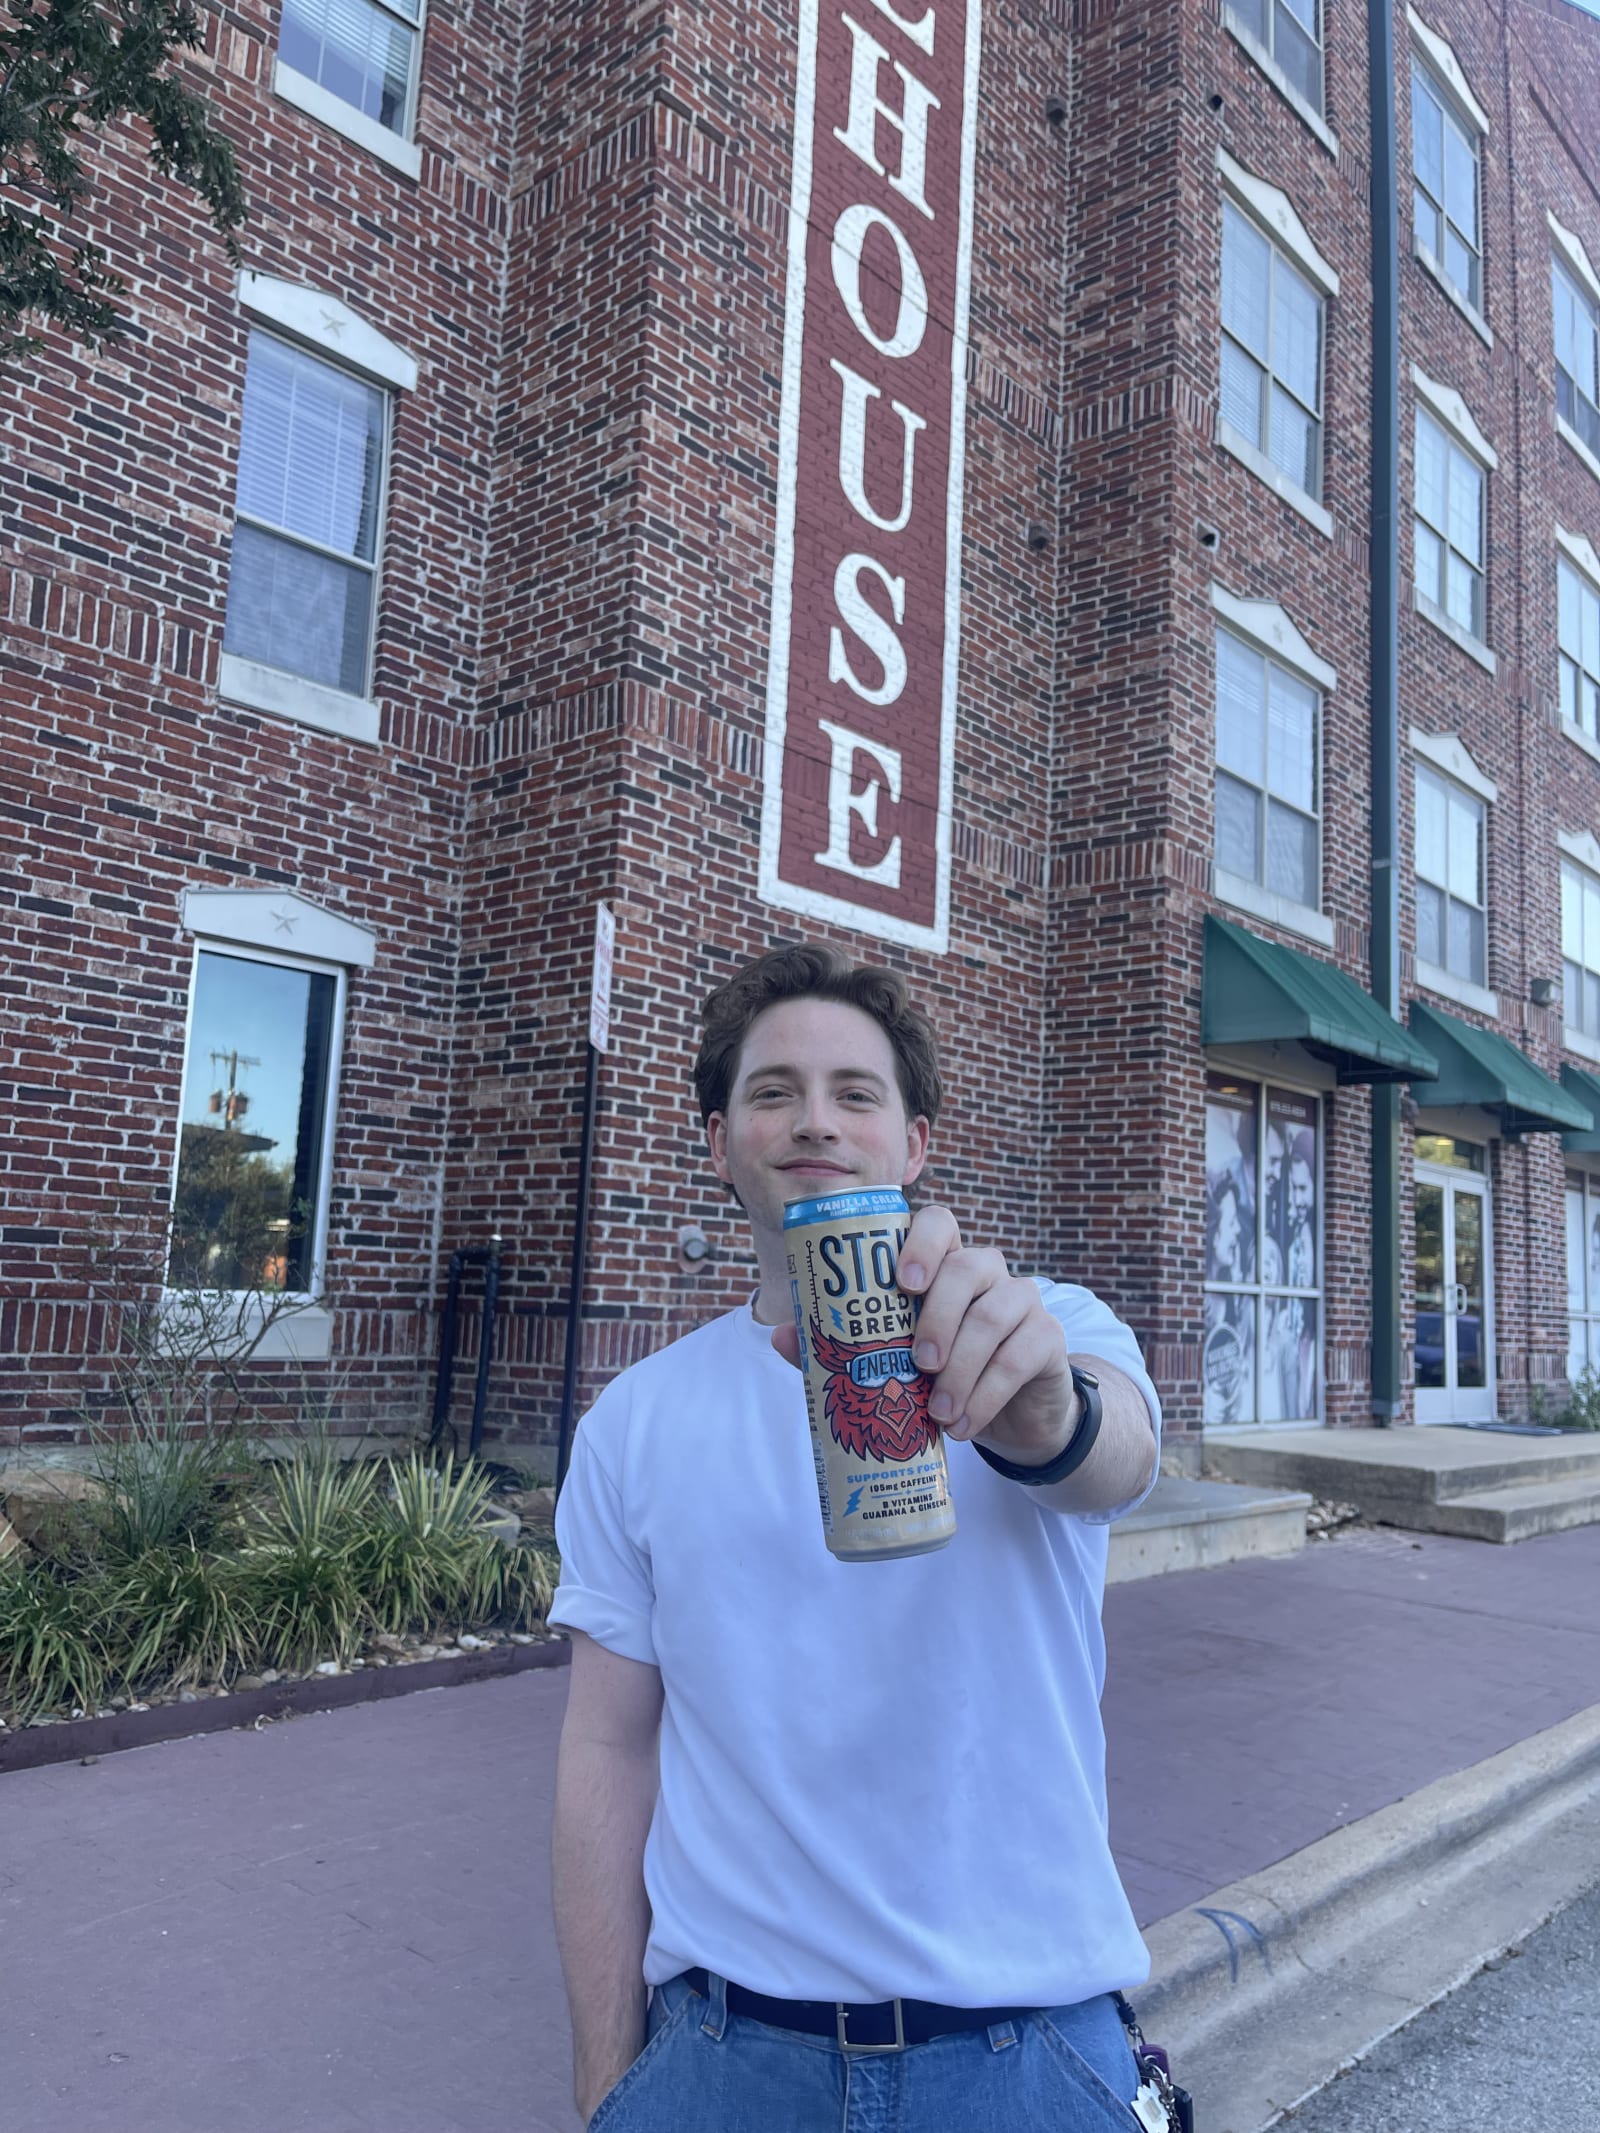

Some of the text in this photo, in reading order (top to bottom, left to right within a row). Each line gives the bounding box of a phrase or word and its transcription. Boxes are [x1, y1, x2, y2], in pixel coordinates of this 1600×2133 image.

[816, 1196, 869, 1213] VANILLA
[846, 1293, 910, 1316] COLD
[849, 1312, 912, 1337] BREW
[847, 1467, 914, 1484] SUPPORTS
[882, 1493, 933, 1509] B VITAMINS
[862, 1508, 907, 1520] GUARANA
[909, 1505, 916, 1513] &
